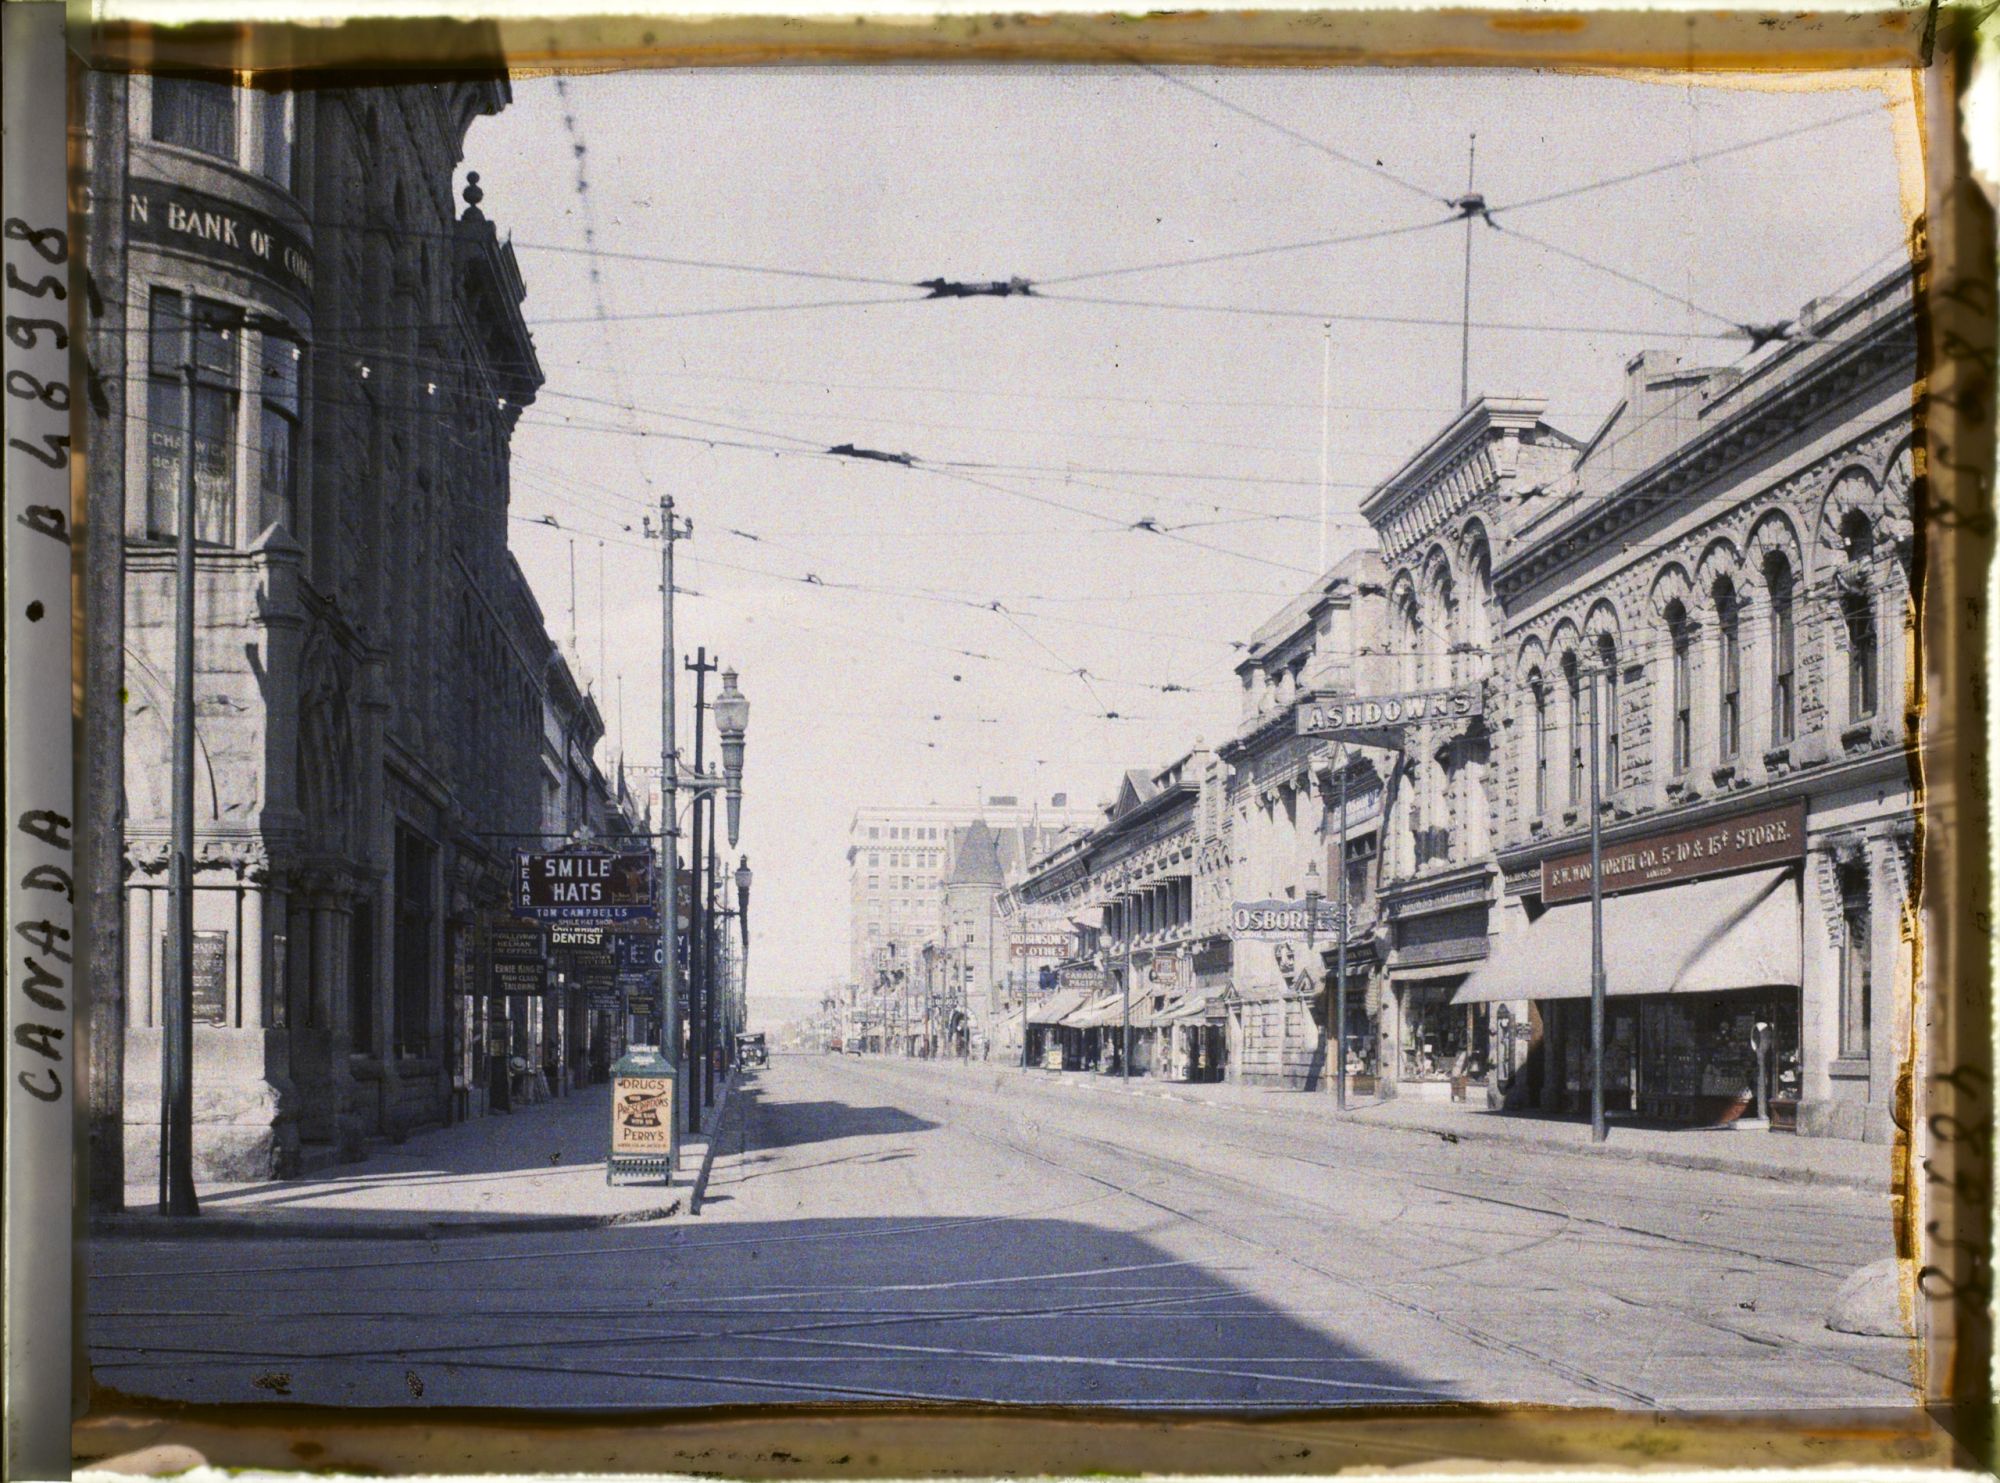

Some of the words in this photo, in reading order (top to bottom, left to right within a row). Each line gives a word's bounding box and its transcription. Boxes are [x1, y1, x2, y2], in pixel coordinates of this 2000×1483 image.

[168, 202, 240, 249] BANK
[249, 228, 275, 259] OF
[5, 218, 72, 469] 48958
[1572, 853, 1636, 882] WOOWORTH
[1638, 849, 1659, 868] CO.
[1692, 839, 1704, 857] &
[520, 855, 531, 906] WEAR
[553, 883, 602, 902] HATS
[536, 908, 558, 918] TOM
[562, 907, 628, 918] CAMPBELLS
[552, 933, 603, 945] DENTIST
[13, 809, 74, 1102] CANADA
[1016, 946, 1065, 956] COTHES
[623, 1079, 665, 1090] DRUGS
[623, 1127, 665, 1141] PERRY'S
